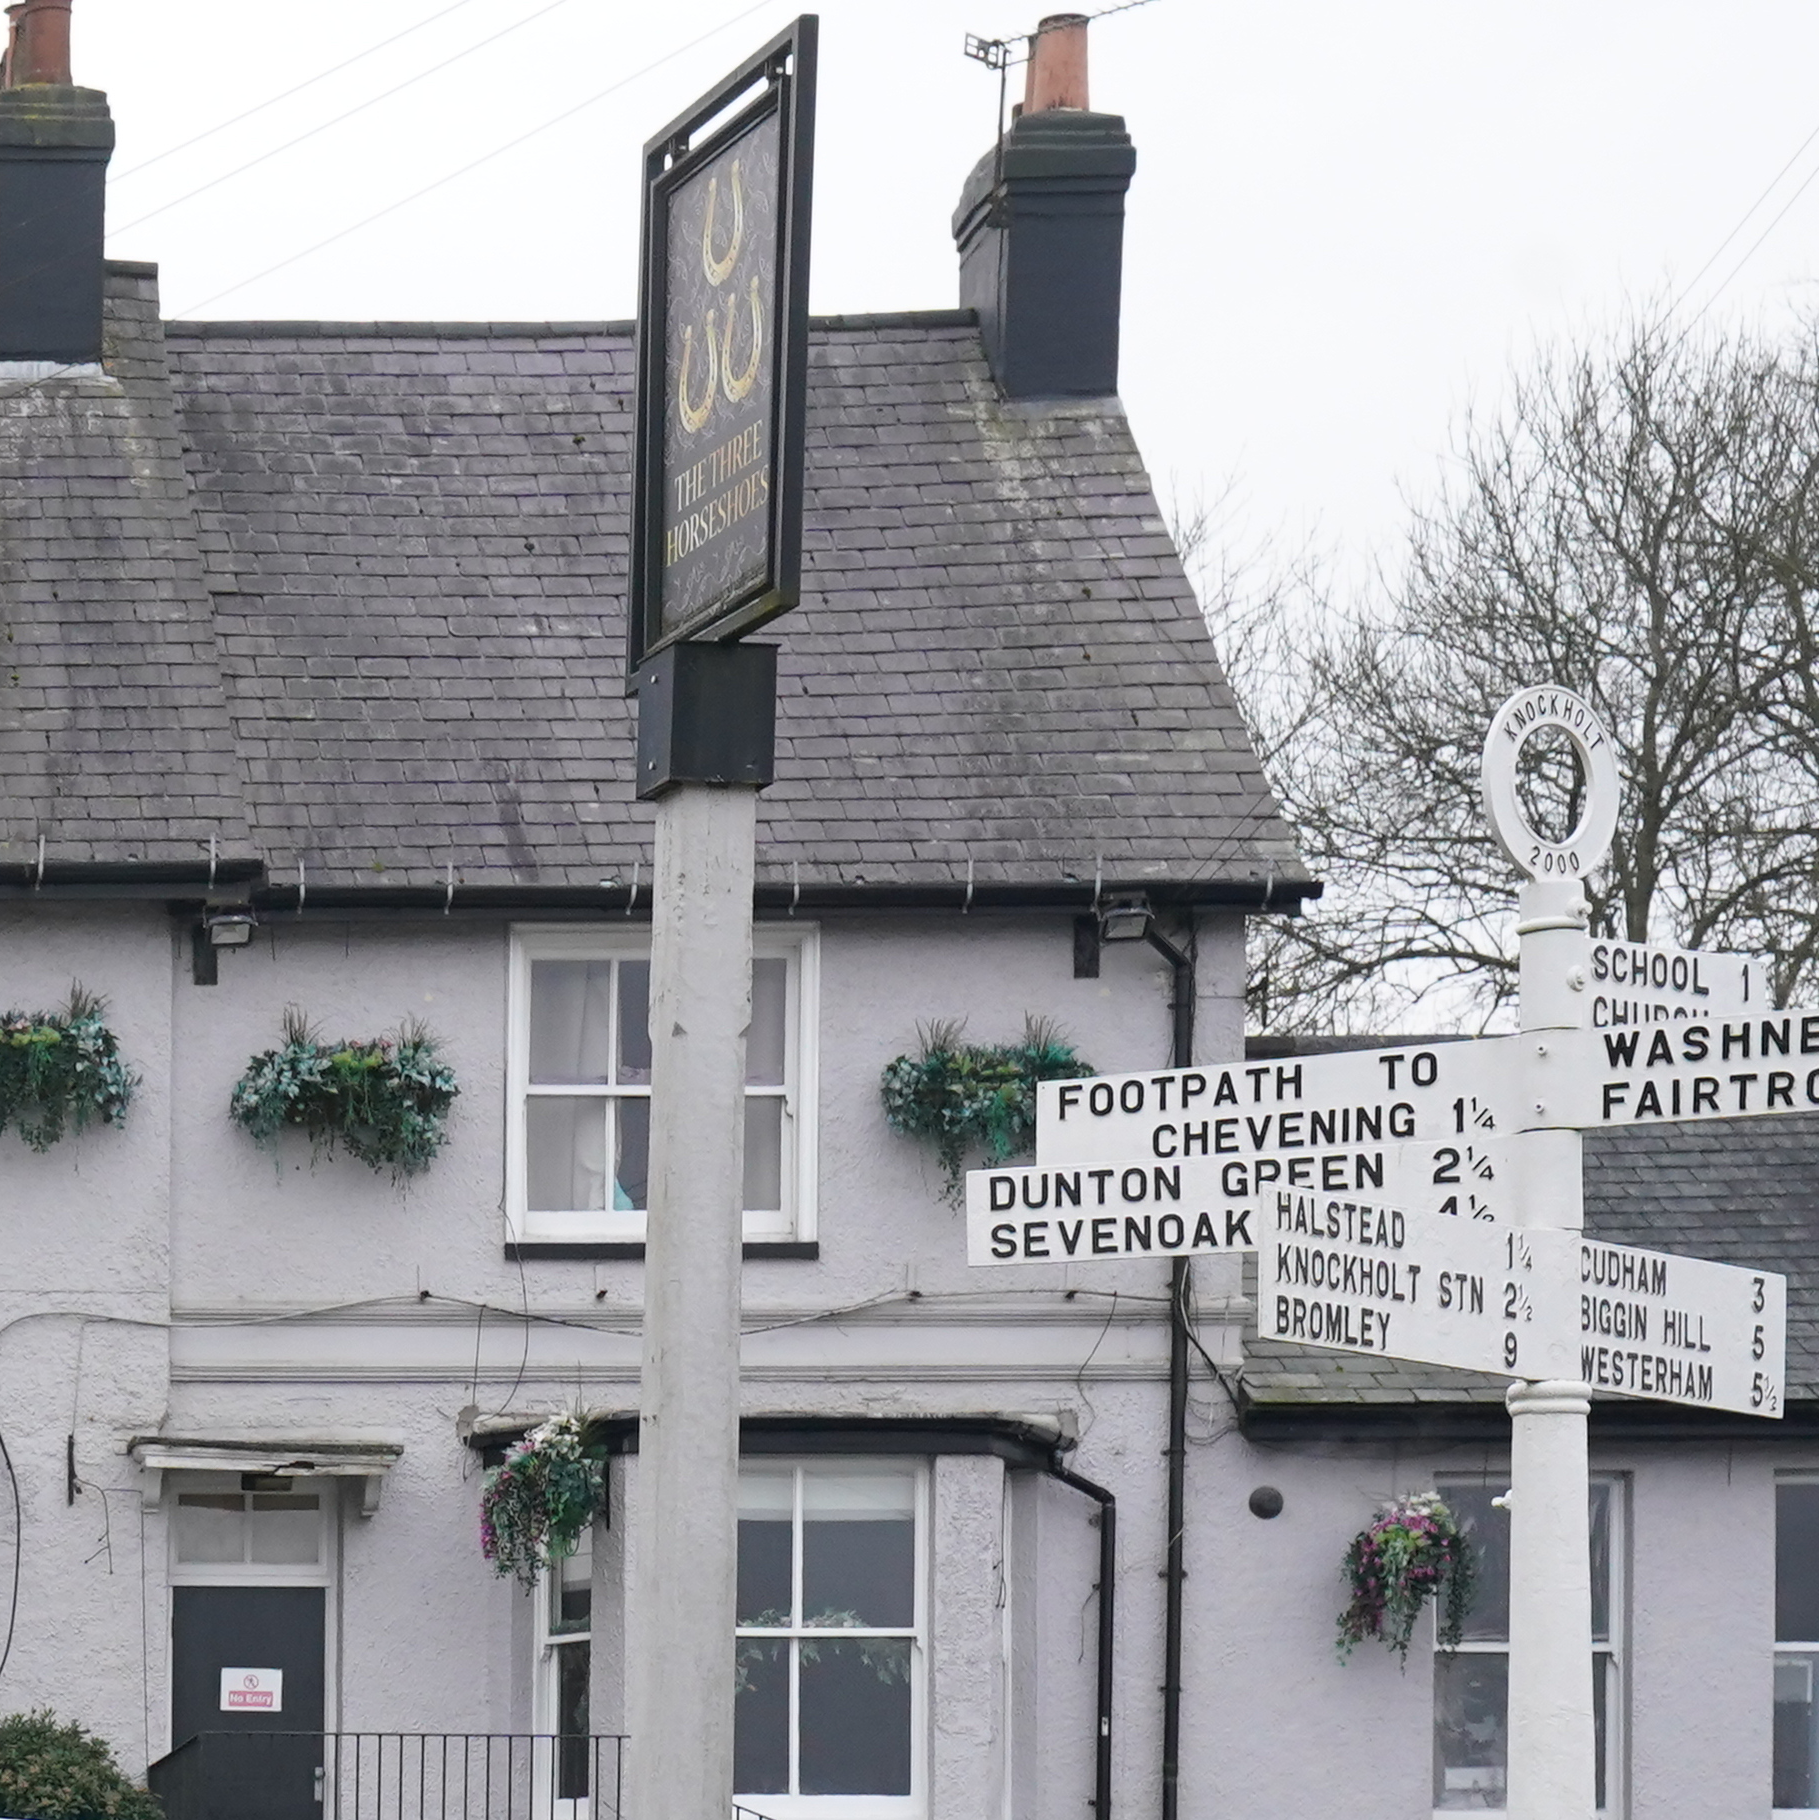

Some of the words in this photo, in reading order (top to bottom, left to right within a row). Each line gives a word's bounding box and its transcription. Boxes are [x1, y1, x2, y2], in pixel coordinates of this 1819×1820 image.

[675, 458, 707, 513] THE
[708, 419, 763, 488] THREE
[666, 464, 769, 568] HORSESHOES
[1504, 694, 1604, 750] KNOCKHOLT
[1530, 847, 1580, 875] 2000
[1593, 944, 1709, 996] SCHOOL
[1741, 963, 1750, 1003] 1
[1603, 1016, 1819, 1068] WASHNE
[1058, 1064, 1303, 1122] FOOTPATH
[1379, 1052, 1439, 1091] TO
[1152, 1102, 1416, 1158] CHEVENING
[989, 1165, 1182, 1212] DUNTON
[1222, 1152, 1385, 1197] GREEN
[990, 1209, 1254, 1259] SEVENOAK
[1276, 1191, 1406, 1249] HALSTEAD
[1276, 1243, 1422, 1304] KNOCKHOLT
[1438, 1271, 1484, 1314] STN
[1581, 1246, 1667, 1297] CUDHAM
[1751, 1277, 1766, 1314] 3
[1276, 1295, 1391, 1350] BROMLEY
[1503, 1331, 1518, 1369] 9
[1581, 1294, 1648, 1341] BIGGIN
[1663, 1309, 1712, 1353] HILL
[1751, 1325, 1766, 1362] 5
[1581, 1344, 1714, 1402] WESTERHAM
[230, 1694, 243, 1703] No
[246, 1693, 272, 1705] Entry
